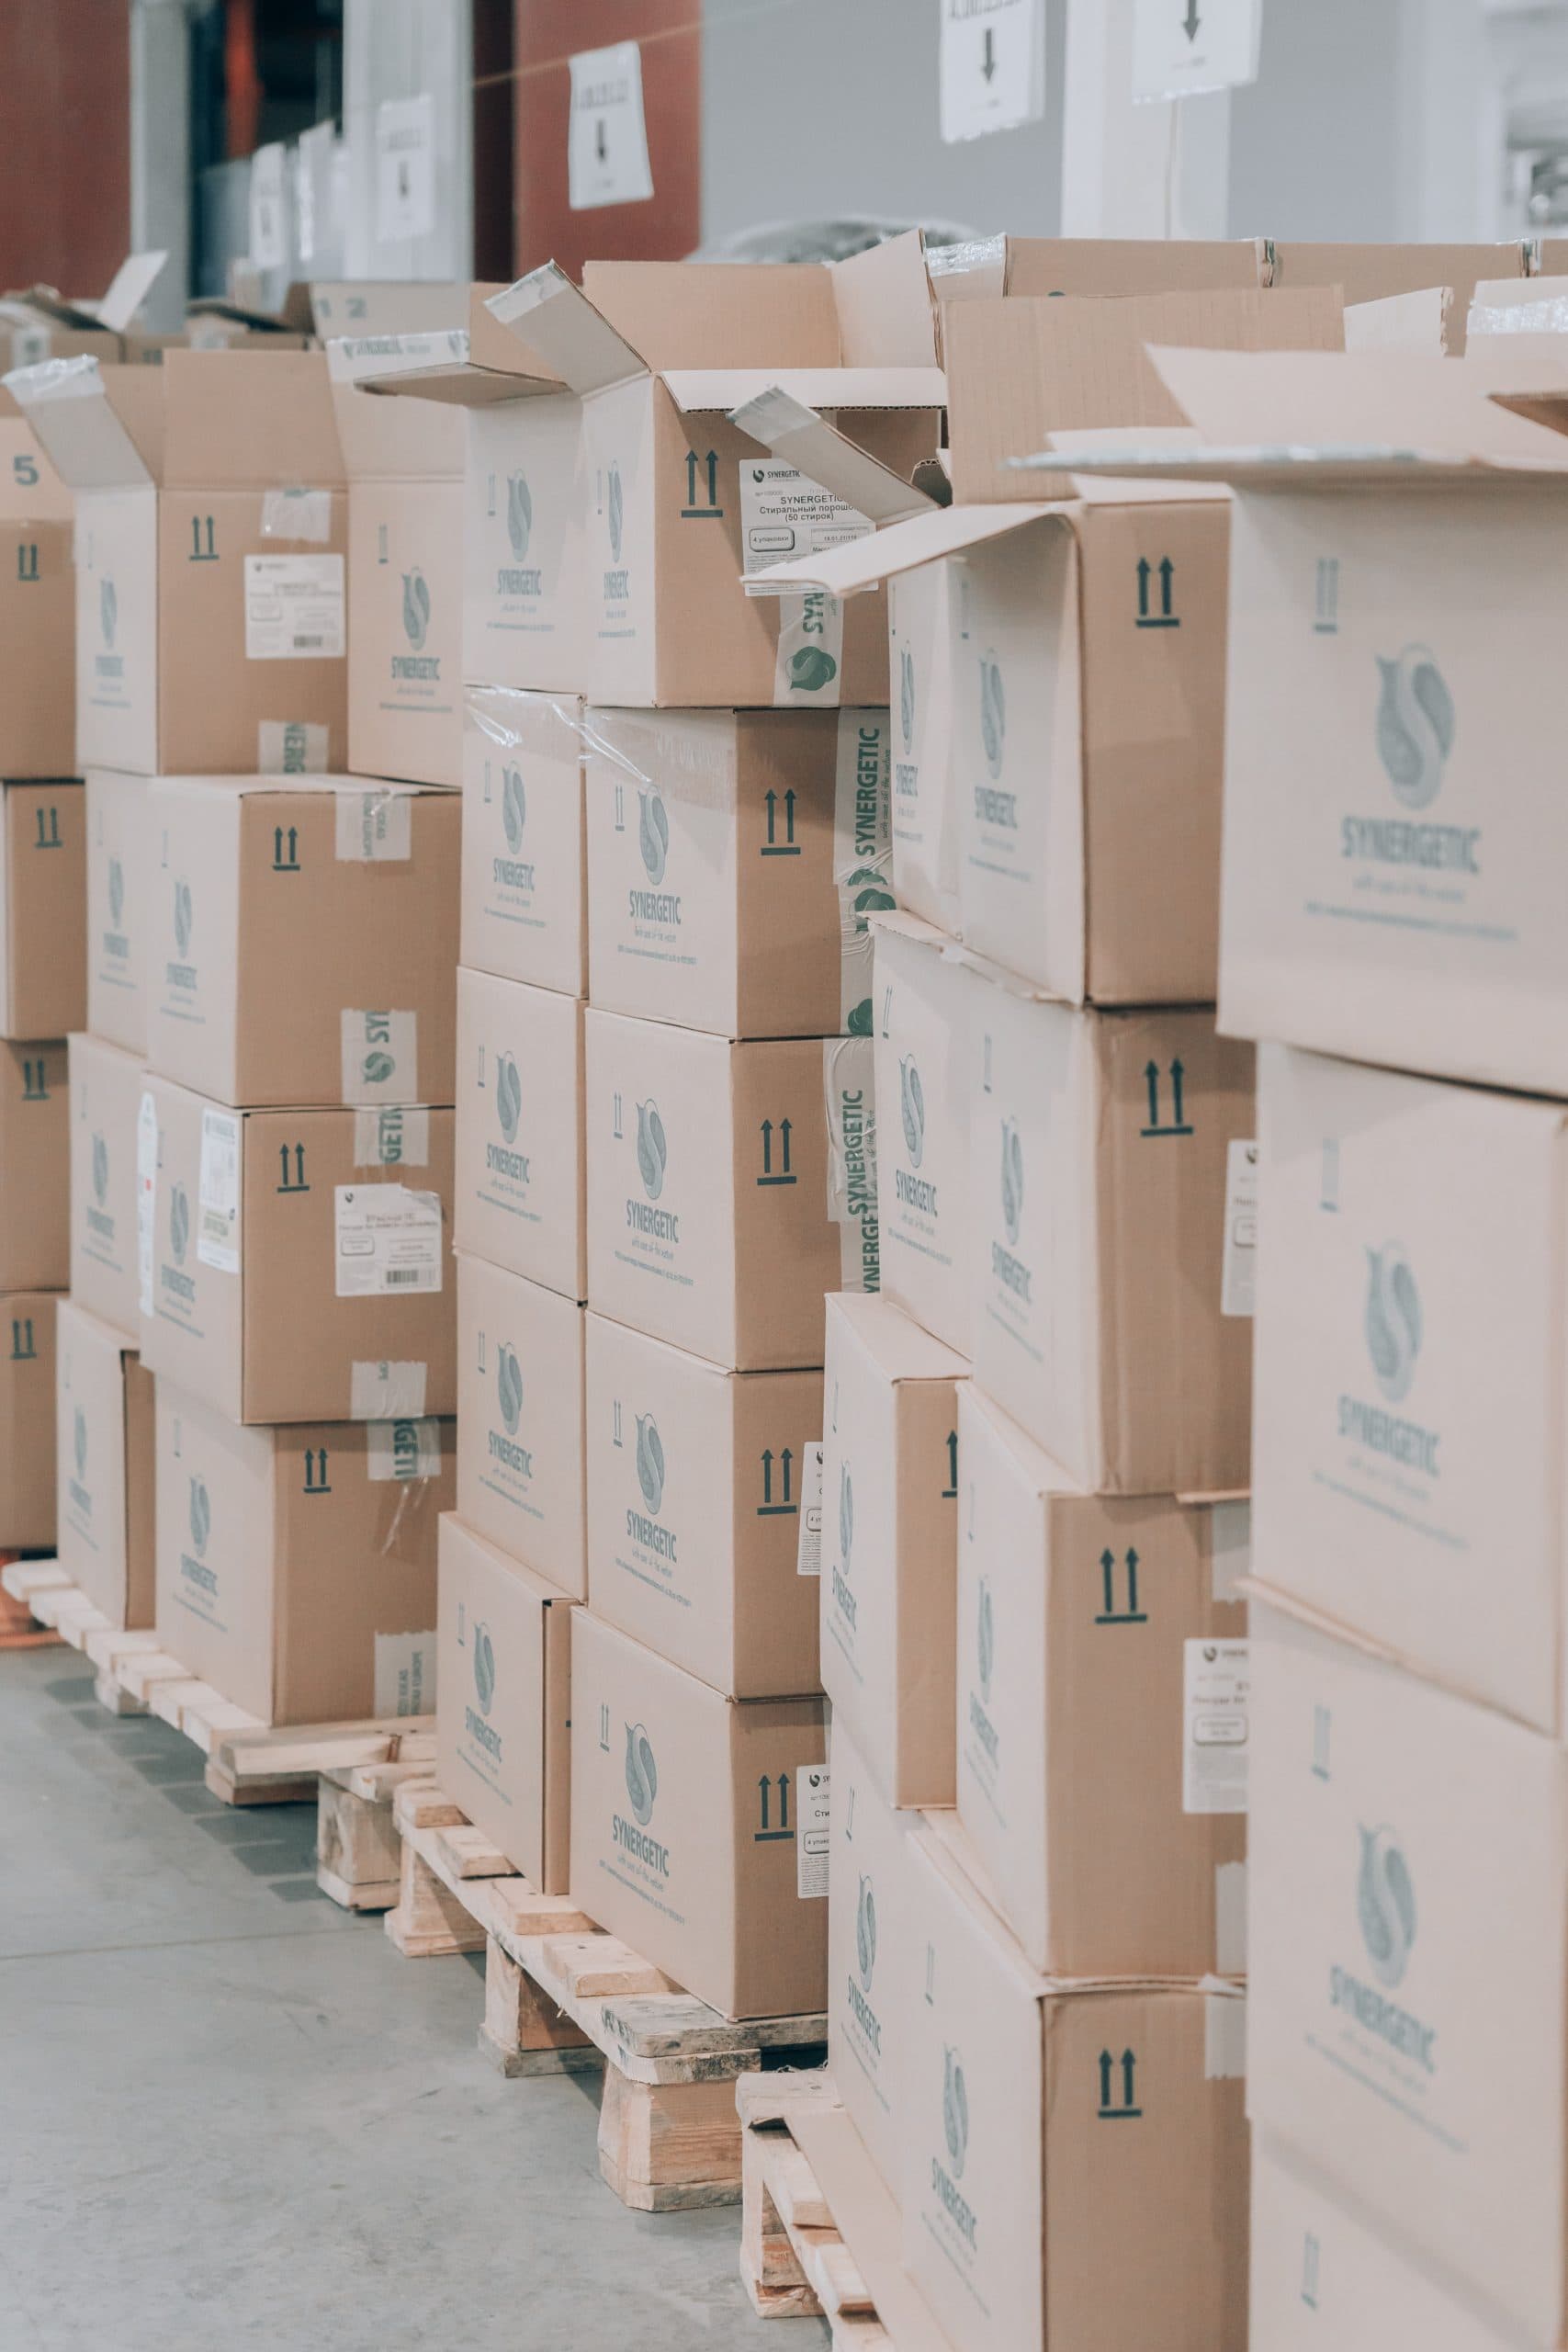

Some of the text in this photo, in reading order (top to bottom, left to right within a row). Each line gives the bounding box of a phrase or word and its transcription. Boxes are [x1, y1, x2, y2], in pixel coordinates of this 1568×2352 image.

[14, 456, 39, 485] 5
[767, 470, 801, 479] SYNERGETIC
[760, 503, 857, 515] Стиральный порошо
[784, 512, 835, 523] (50 стирок)
[497, 569, 542, 595] SYNERGETIC
[392, 656, 440, 680] SYNERGETIC
[855, 727, 880, 856] SYNERGETIC
[1342, 816, 1481, 875] SYNERGETIC
[493, 857, 535, 891] SYNERGETIC
[629, 888, 681, 925] SYNERGETIC
[486, 1143, 530, 1184] SYNERGETIC
[842, 1090, 868, 1216] SYNERGETIC
[896, 1169, 938, 1218] SYNERGETIC
[626, 1198, 679, 1243] SYNERGETIC
[488, 1430, 532, 1479] SYNERGETIC
[1337, 1394, 1440, 1478] SYNERGETIC
[626, 1509, 678, 1564] SYNERGETIC
[466, 1705, 502, 1763] SYNERGETIC
[613, 1813, 669, 1877] SYNERGETIC
[847, 1974, 881, 2056] SYNERGETIC
[1330, 1963, 1436, 2075] SYNERGETIC
[931, 2156, 977, 2252] SYNERGETIC
